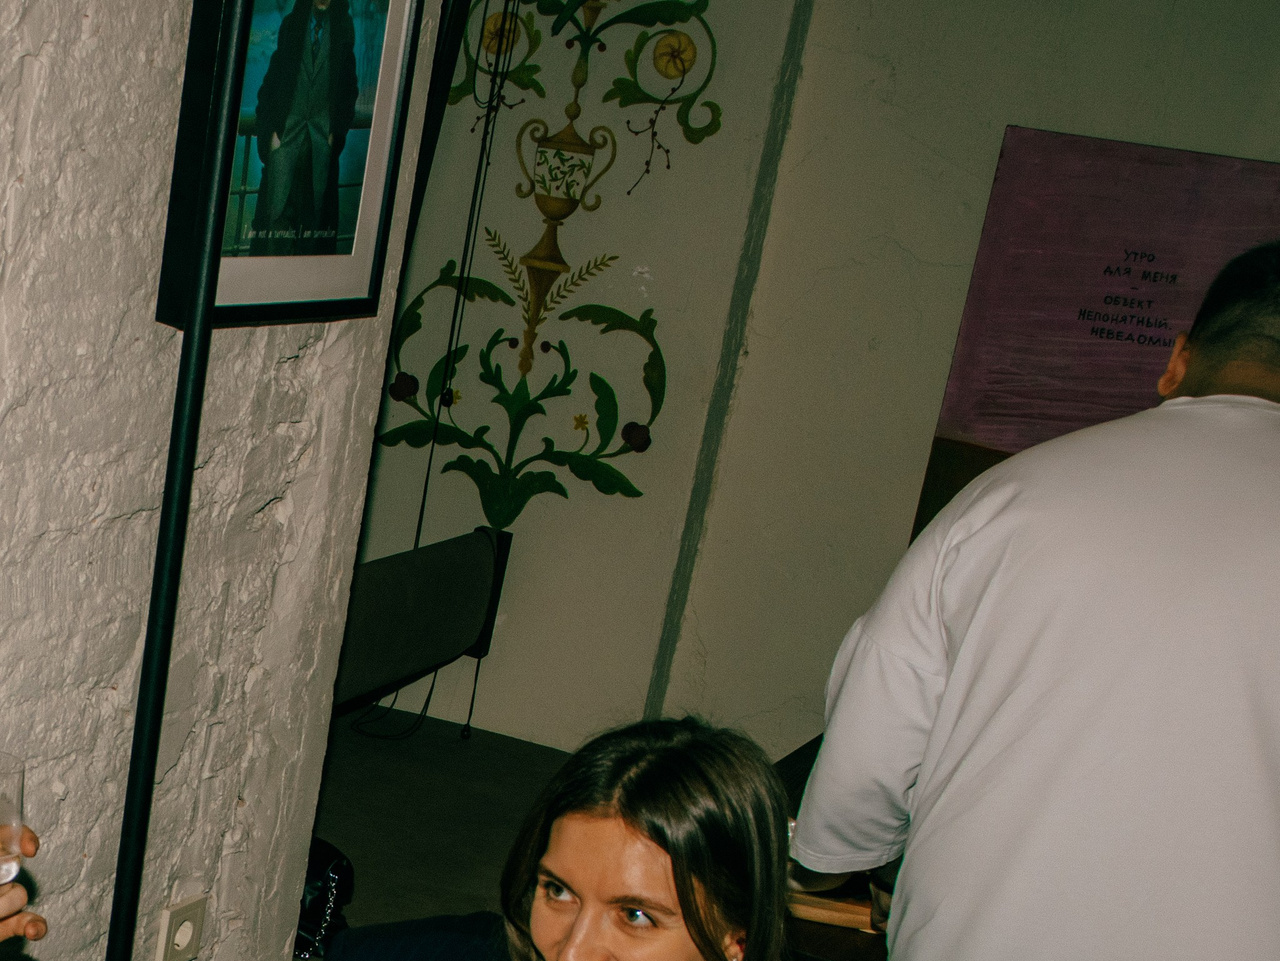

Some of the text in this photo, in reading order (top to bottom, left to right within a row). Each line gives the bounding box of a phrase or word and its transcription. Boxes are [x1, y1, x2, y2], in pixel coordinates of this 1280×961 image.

[1124, 249, 1156, 263] УТРО
[1103, 265, 1179, 284] ДЛЯ МЕНЯ
[1103, 295, 1154, 309] ОБЪЕКТ
